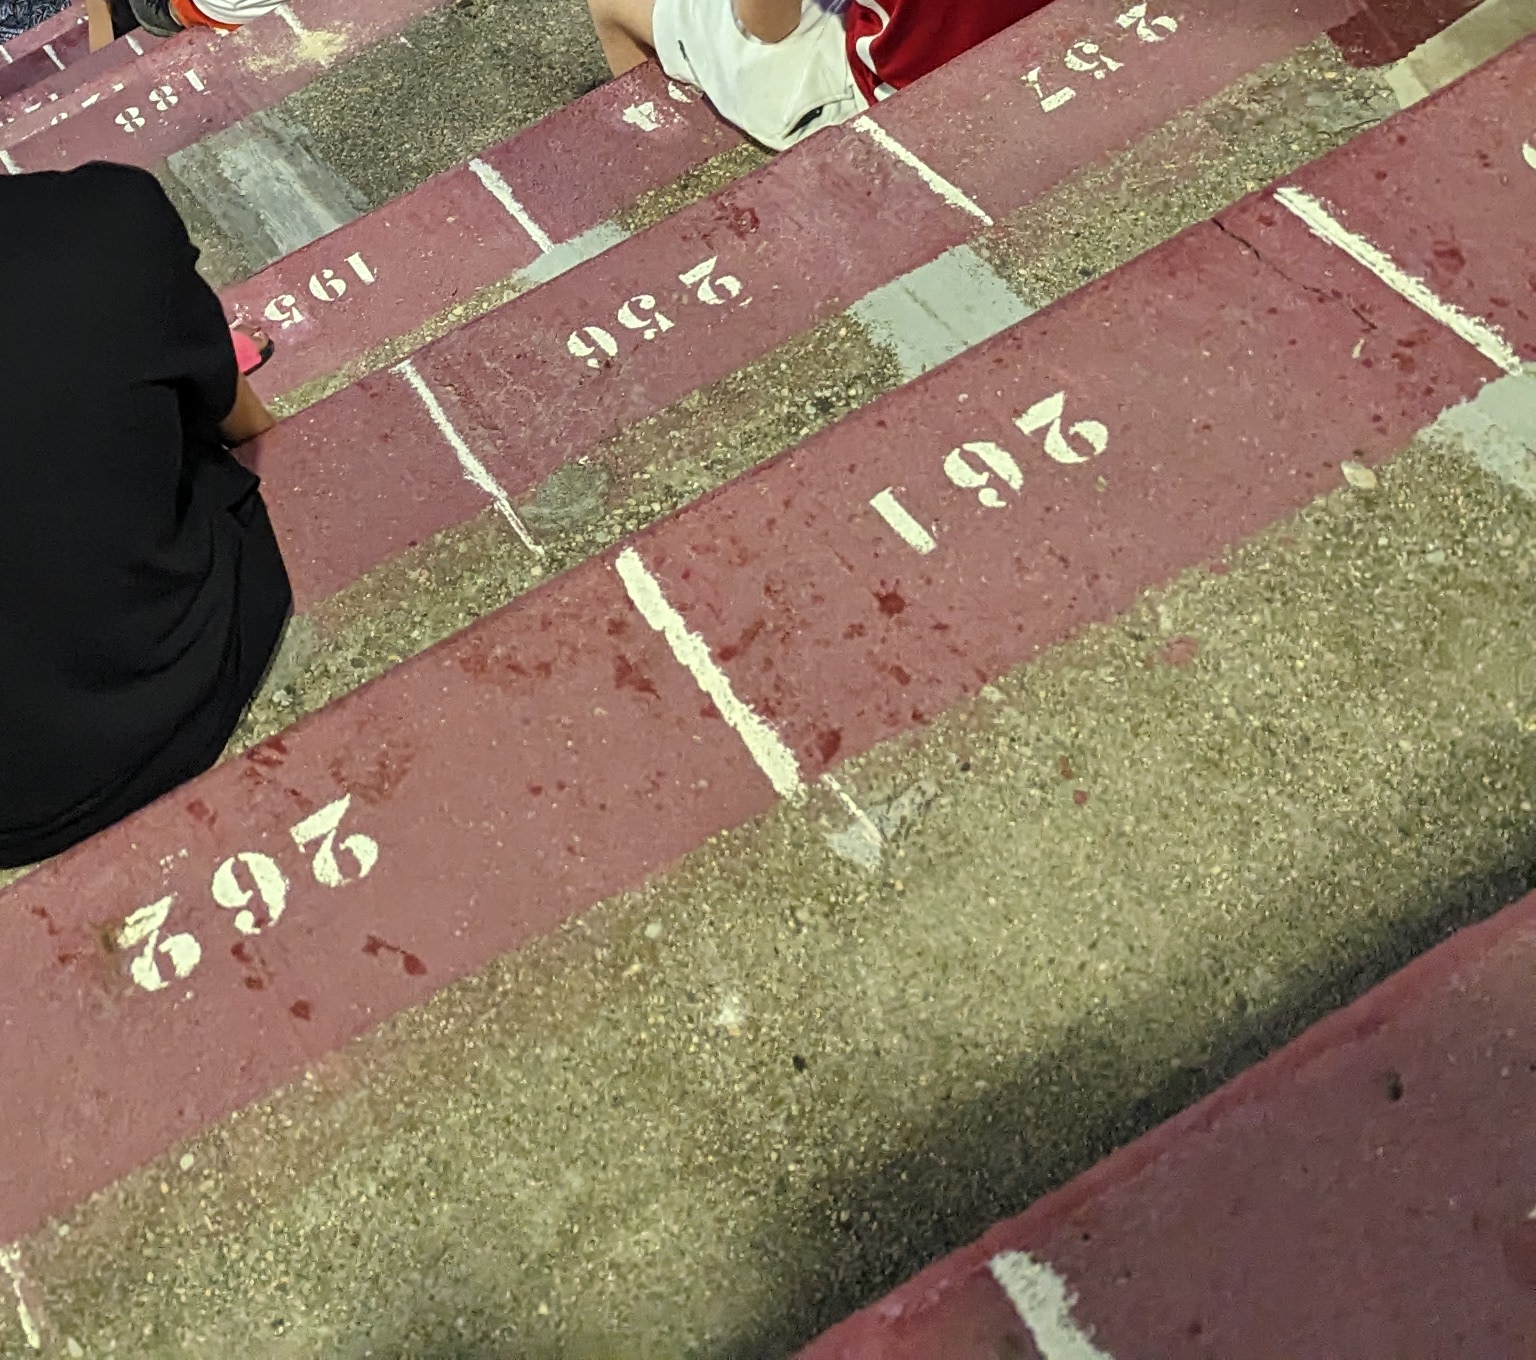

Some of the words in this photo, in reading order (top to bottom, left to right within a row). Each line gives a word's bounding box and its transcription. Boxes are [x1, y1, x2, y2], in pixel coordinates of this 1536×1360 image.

[114, 67, 207, 133] 188
[1020, 1, 1178, 114] 257
[264, 251, 377, 331] 195
[566, 255, 743, 369] 256
[869, 390, 1110, 555] 261
[116, 793, 379, 995] 262
